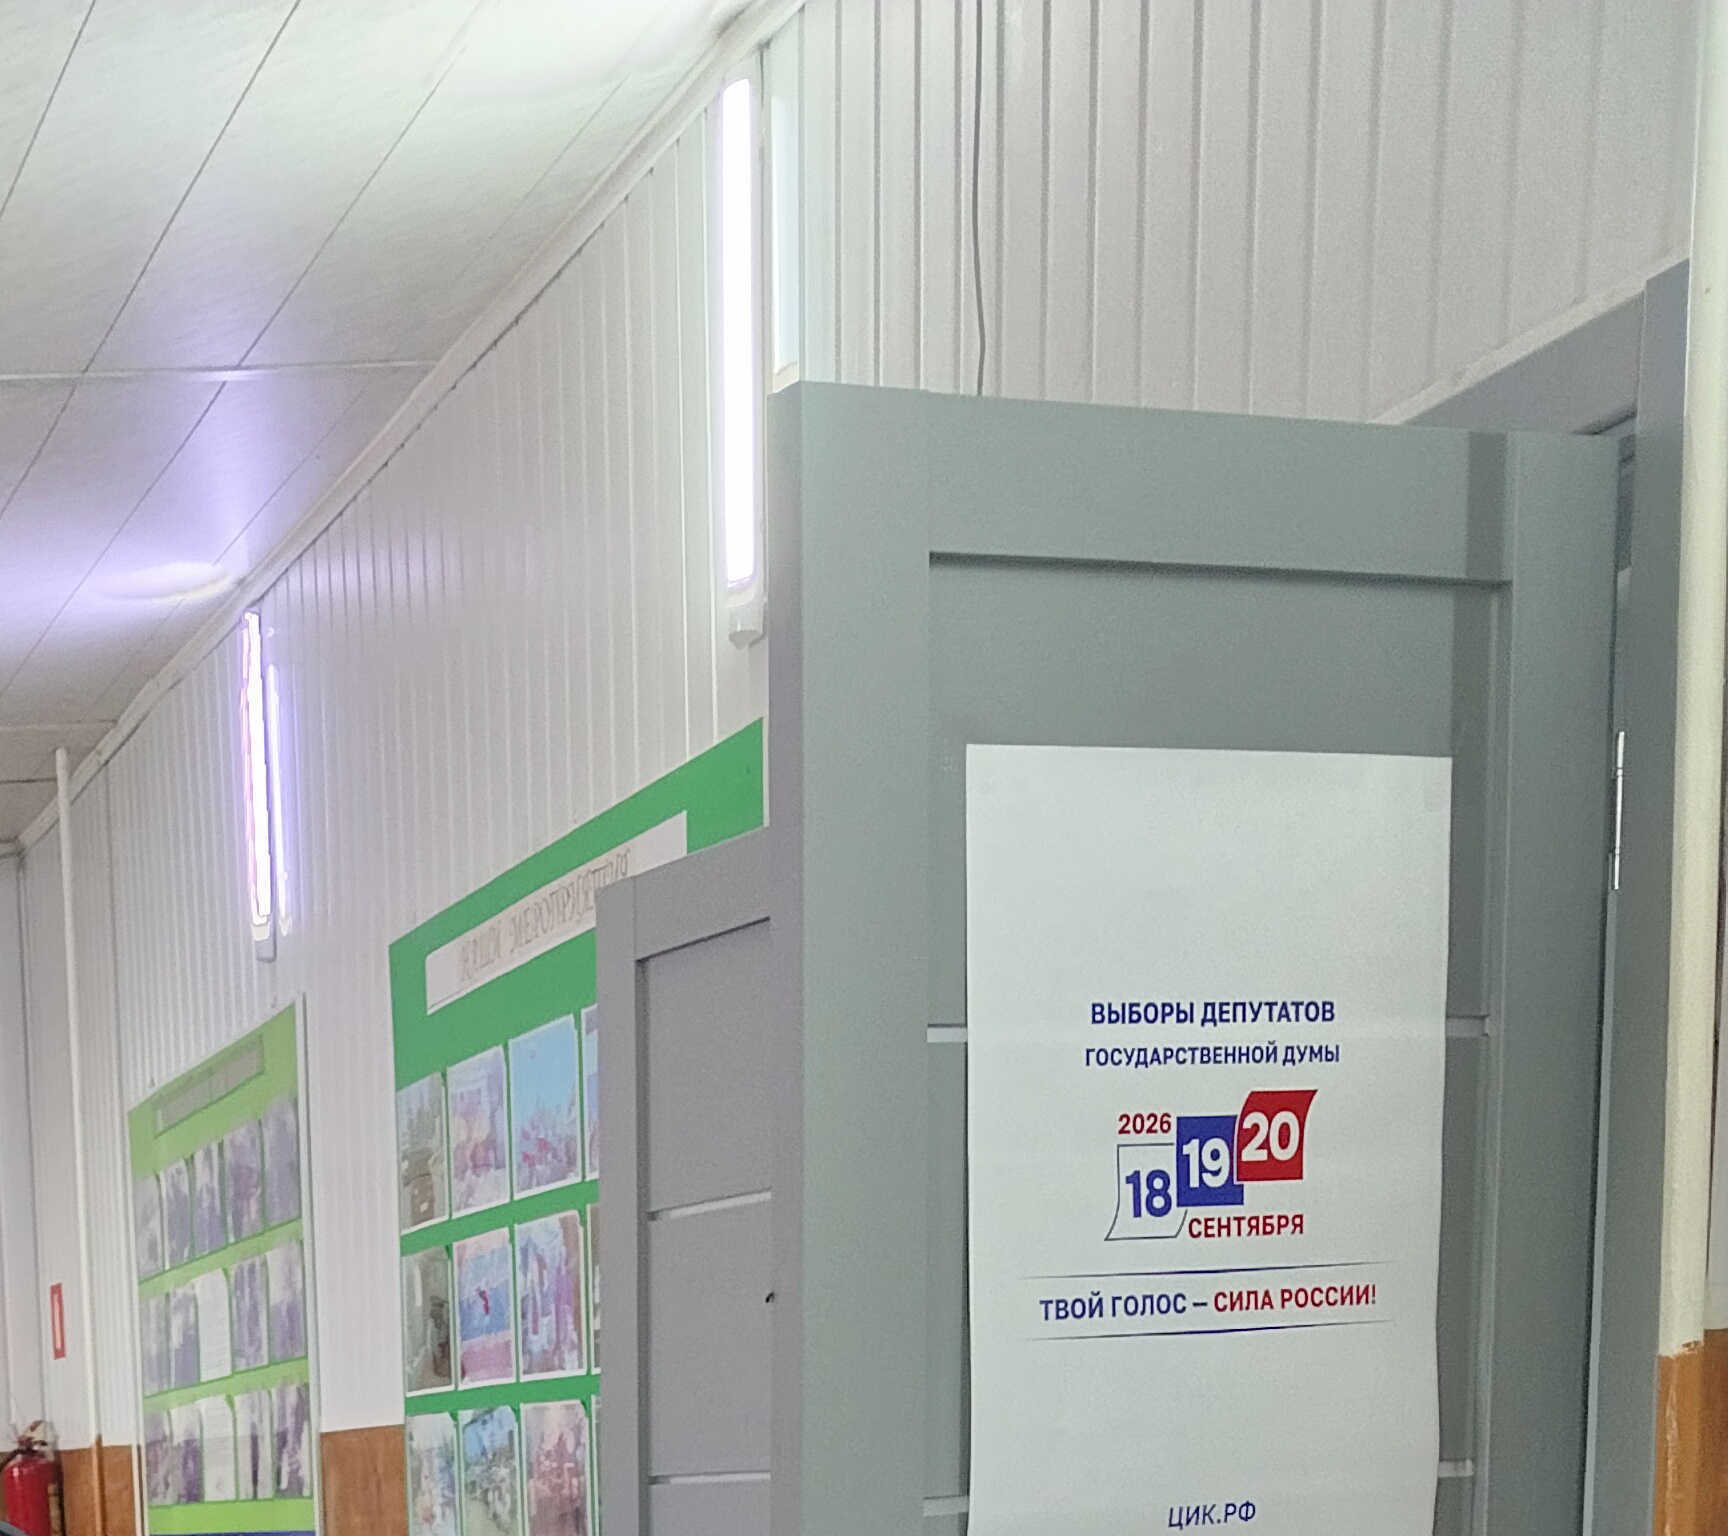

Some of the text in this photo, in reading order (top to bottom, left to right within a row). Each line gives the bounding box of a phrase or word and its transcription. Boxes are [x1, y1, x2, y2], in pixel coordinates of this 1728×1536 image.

[1090, 1000, 1336, 1027] ВЫБОРЫ ДЕПУТАТОВ
[1085, 1040, 1340, 1069] ГОСУДАРСТВЕННОЙ ДУМЫ
[1117, 1112, 1173, 1135] 2026
[1125, 1110, 1301, 1219] 18 19 20
[1188, 1213, 1305, 1239] СЕНТЯБРЯ
[1039, 1290, 1104, 1321] ТВОЙ
[1111, 1292, 1187, 1318] ГОЛОС
[1213, 1289, 1275, 1313] СИЛА
[1280, 1284, 1377, 1310] РОССИИ!
[1167, 1500, 1257, 1531] ЦИК.РФ
